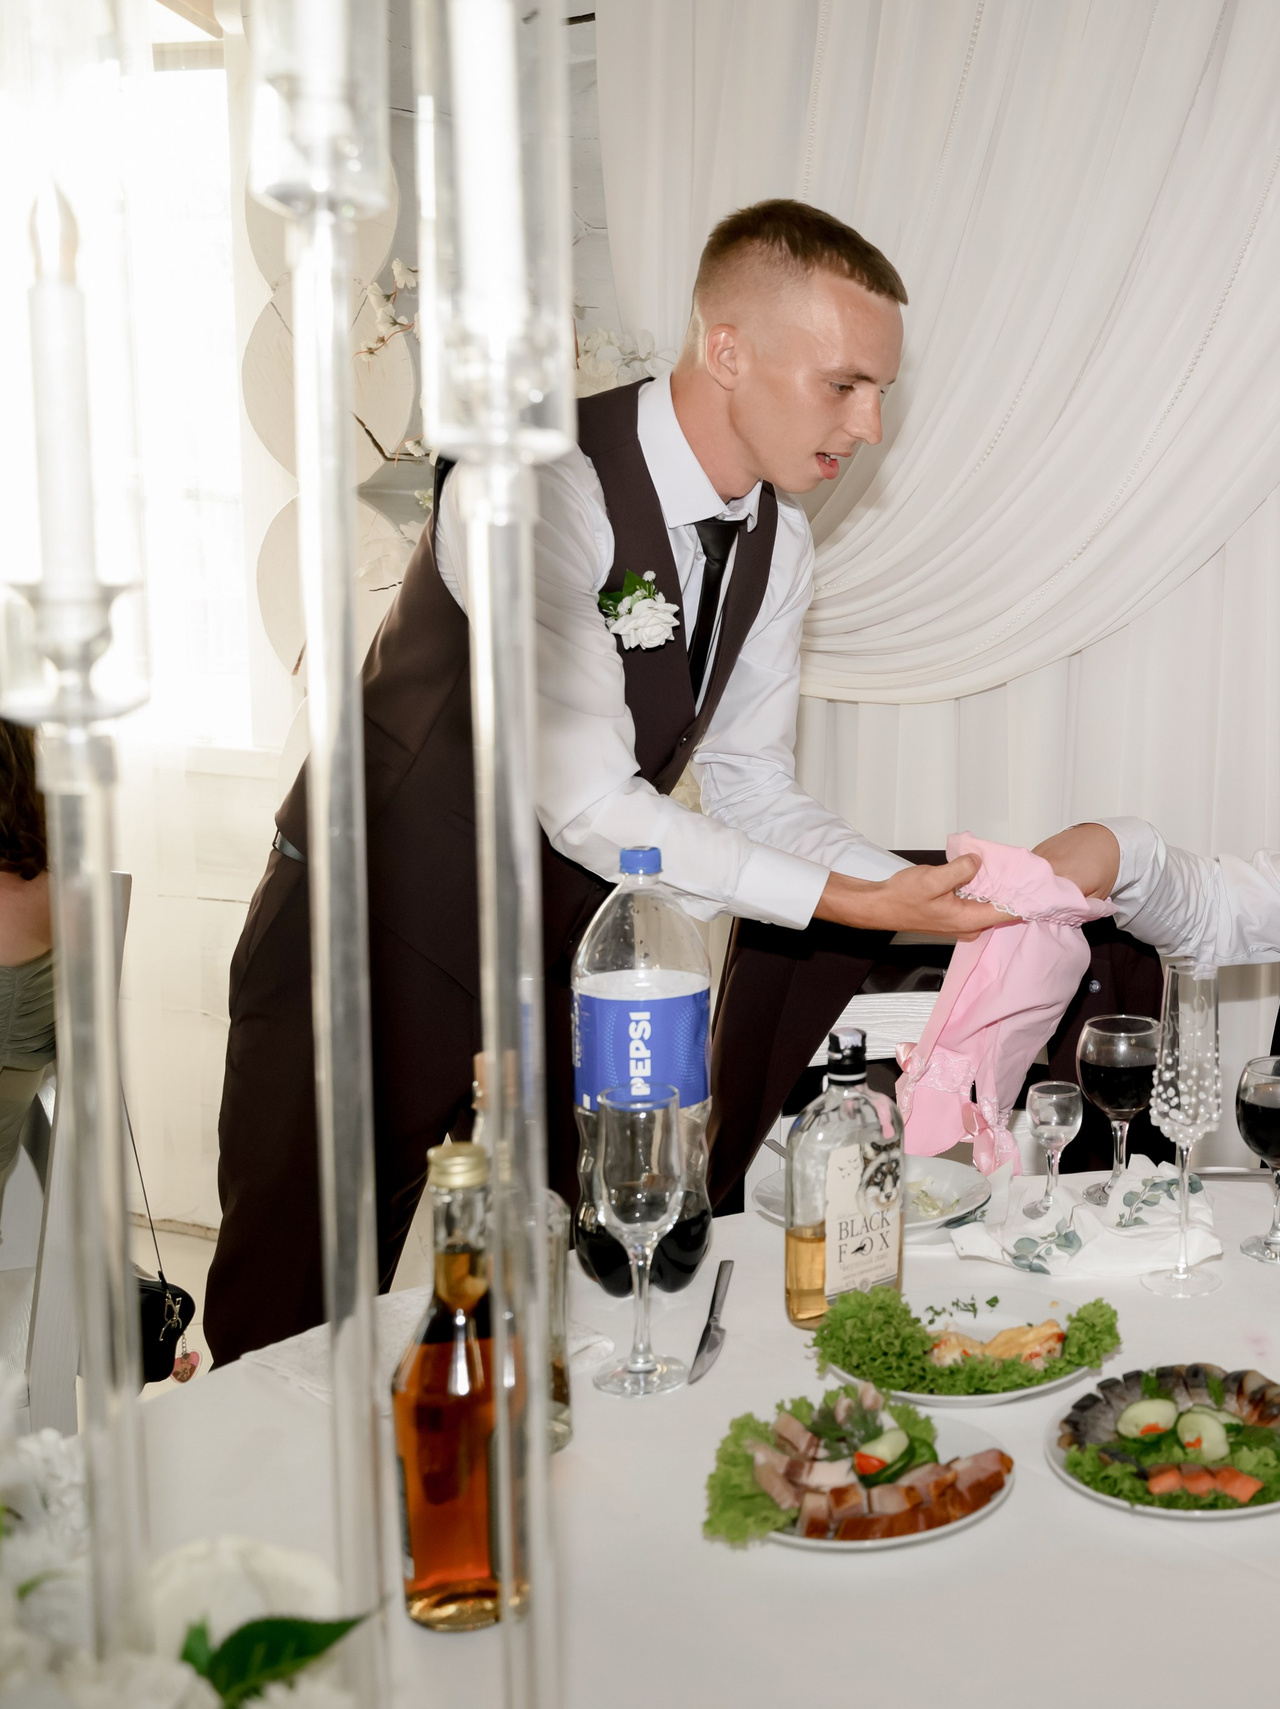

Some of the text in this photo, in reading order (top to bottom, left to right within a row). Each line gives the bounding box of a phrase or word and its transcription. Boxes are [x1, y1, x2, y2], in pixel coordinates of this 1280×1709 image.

[628, 1011, 651, 1096] PEPSI
[838, 1209, 890, 1241] BLACK
[838, 1230, 890, 1263] FOX
